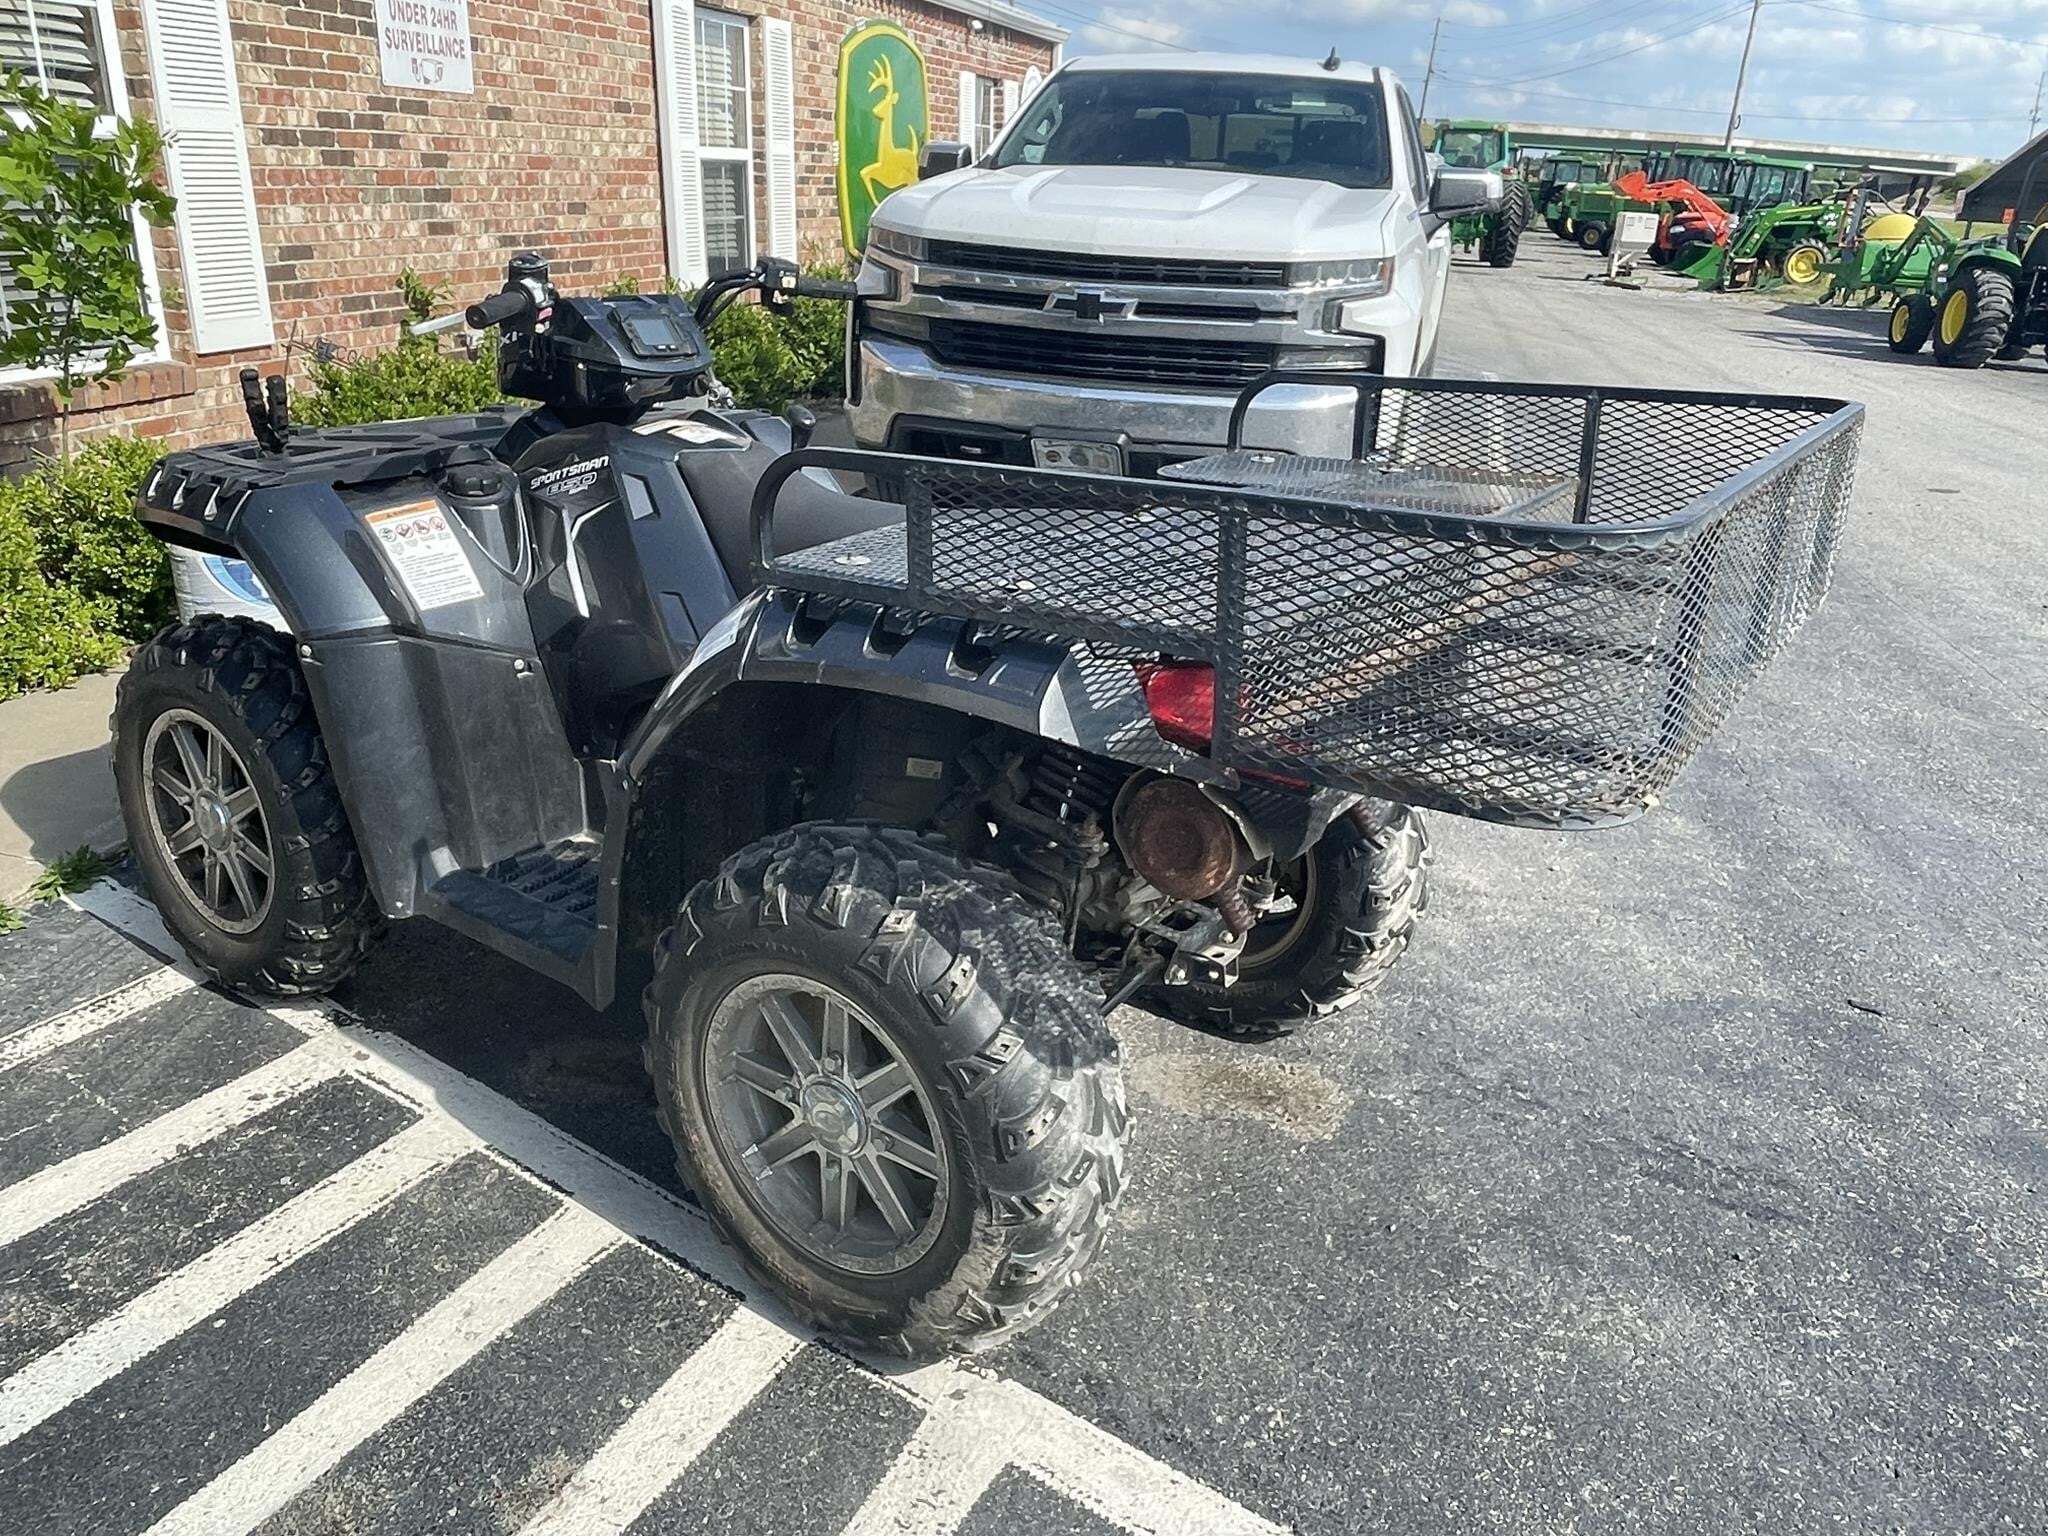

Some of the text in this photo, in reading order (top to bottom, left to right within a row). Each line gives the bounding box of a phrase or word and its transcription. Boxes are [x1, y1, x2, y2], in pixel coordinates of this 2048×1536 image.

[388, 0, 458, 31] UNDER 24HR
[385, 27, 466, 60] SURVEILLANCE
[530, 455, 609, 490] SPORTSMAN
